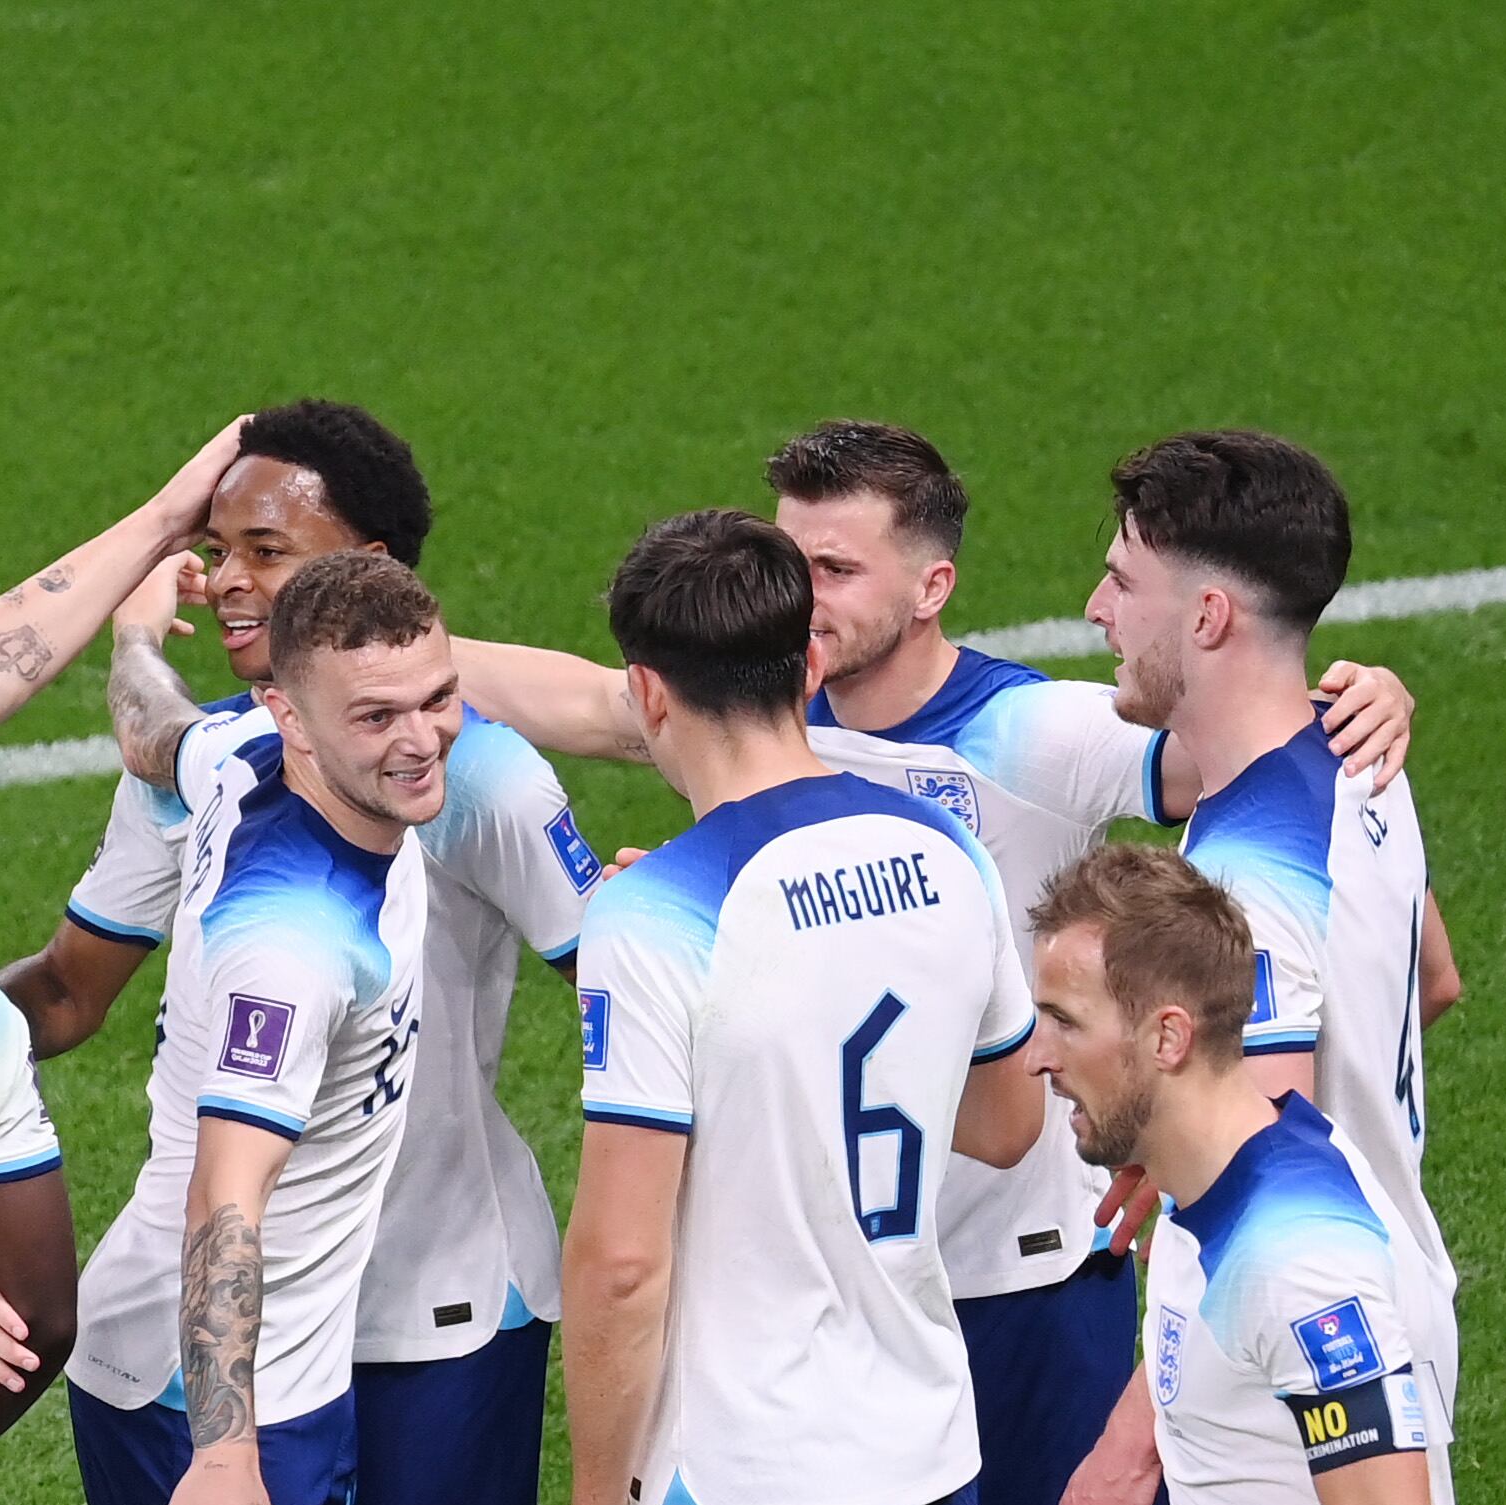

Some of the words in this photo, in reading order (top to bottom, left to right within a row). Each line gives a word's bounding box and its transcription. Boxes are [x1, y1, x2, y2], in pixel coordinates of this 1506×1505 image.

[779, 852, 941, 930] MAGUIRE
[839, 987, 926, 1245] 6
[1303, 1401, 1348, 1445] NO
